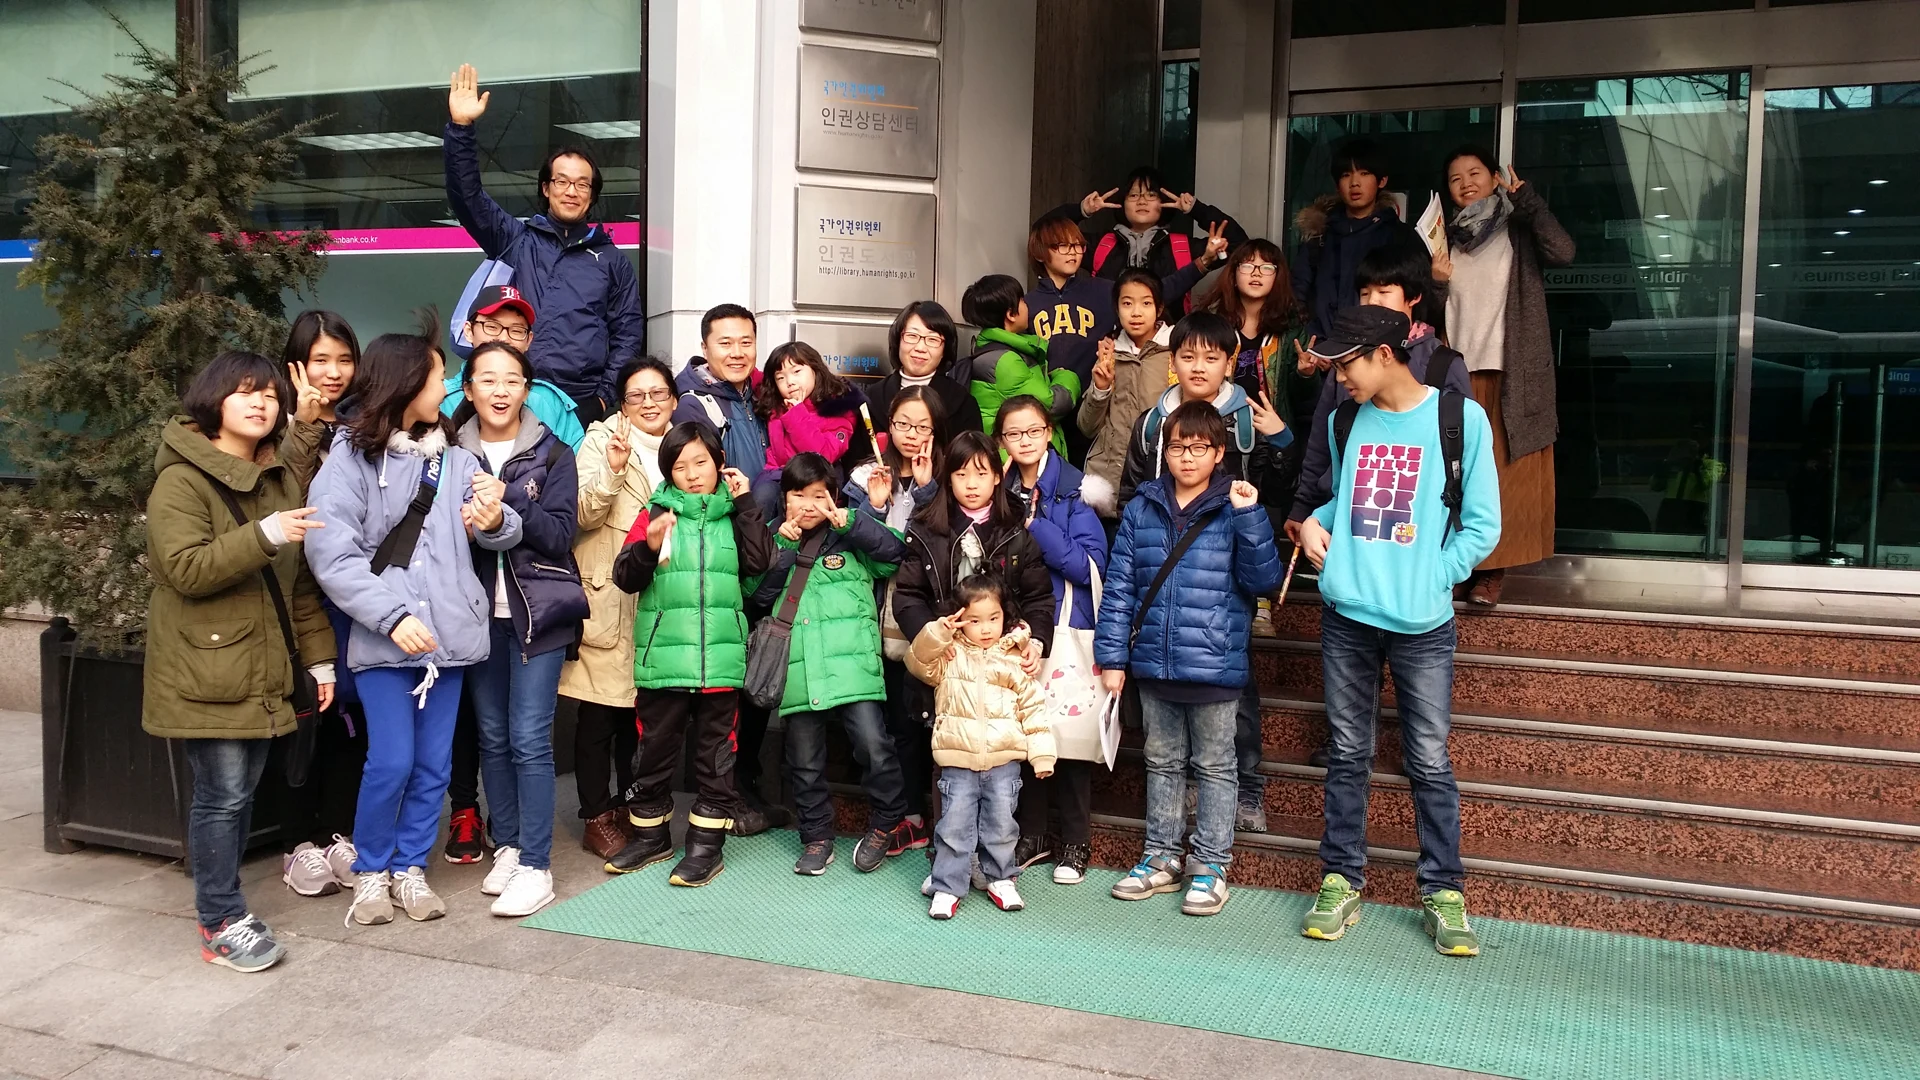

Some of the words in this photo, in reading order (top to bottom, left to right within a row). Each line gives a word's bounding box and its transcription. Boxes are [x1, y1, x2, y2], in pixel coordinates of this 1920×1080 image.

[824, 80, 885, 101] 국가인권위원회
[821, 107, 919, 134] 인권상담센터
[819, 218, 882, 236] 국가인권위원회
[1633, 270, 1704, 284] uilding
[1033, 303, 1095, 341] GAP
[823, 355, 879, 372] 가인권위원회
[1352, 486, 1415, 512] FOR
